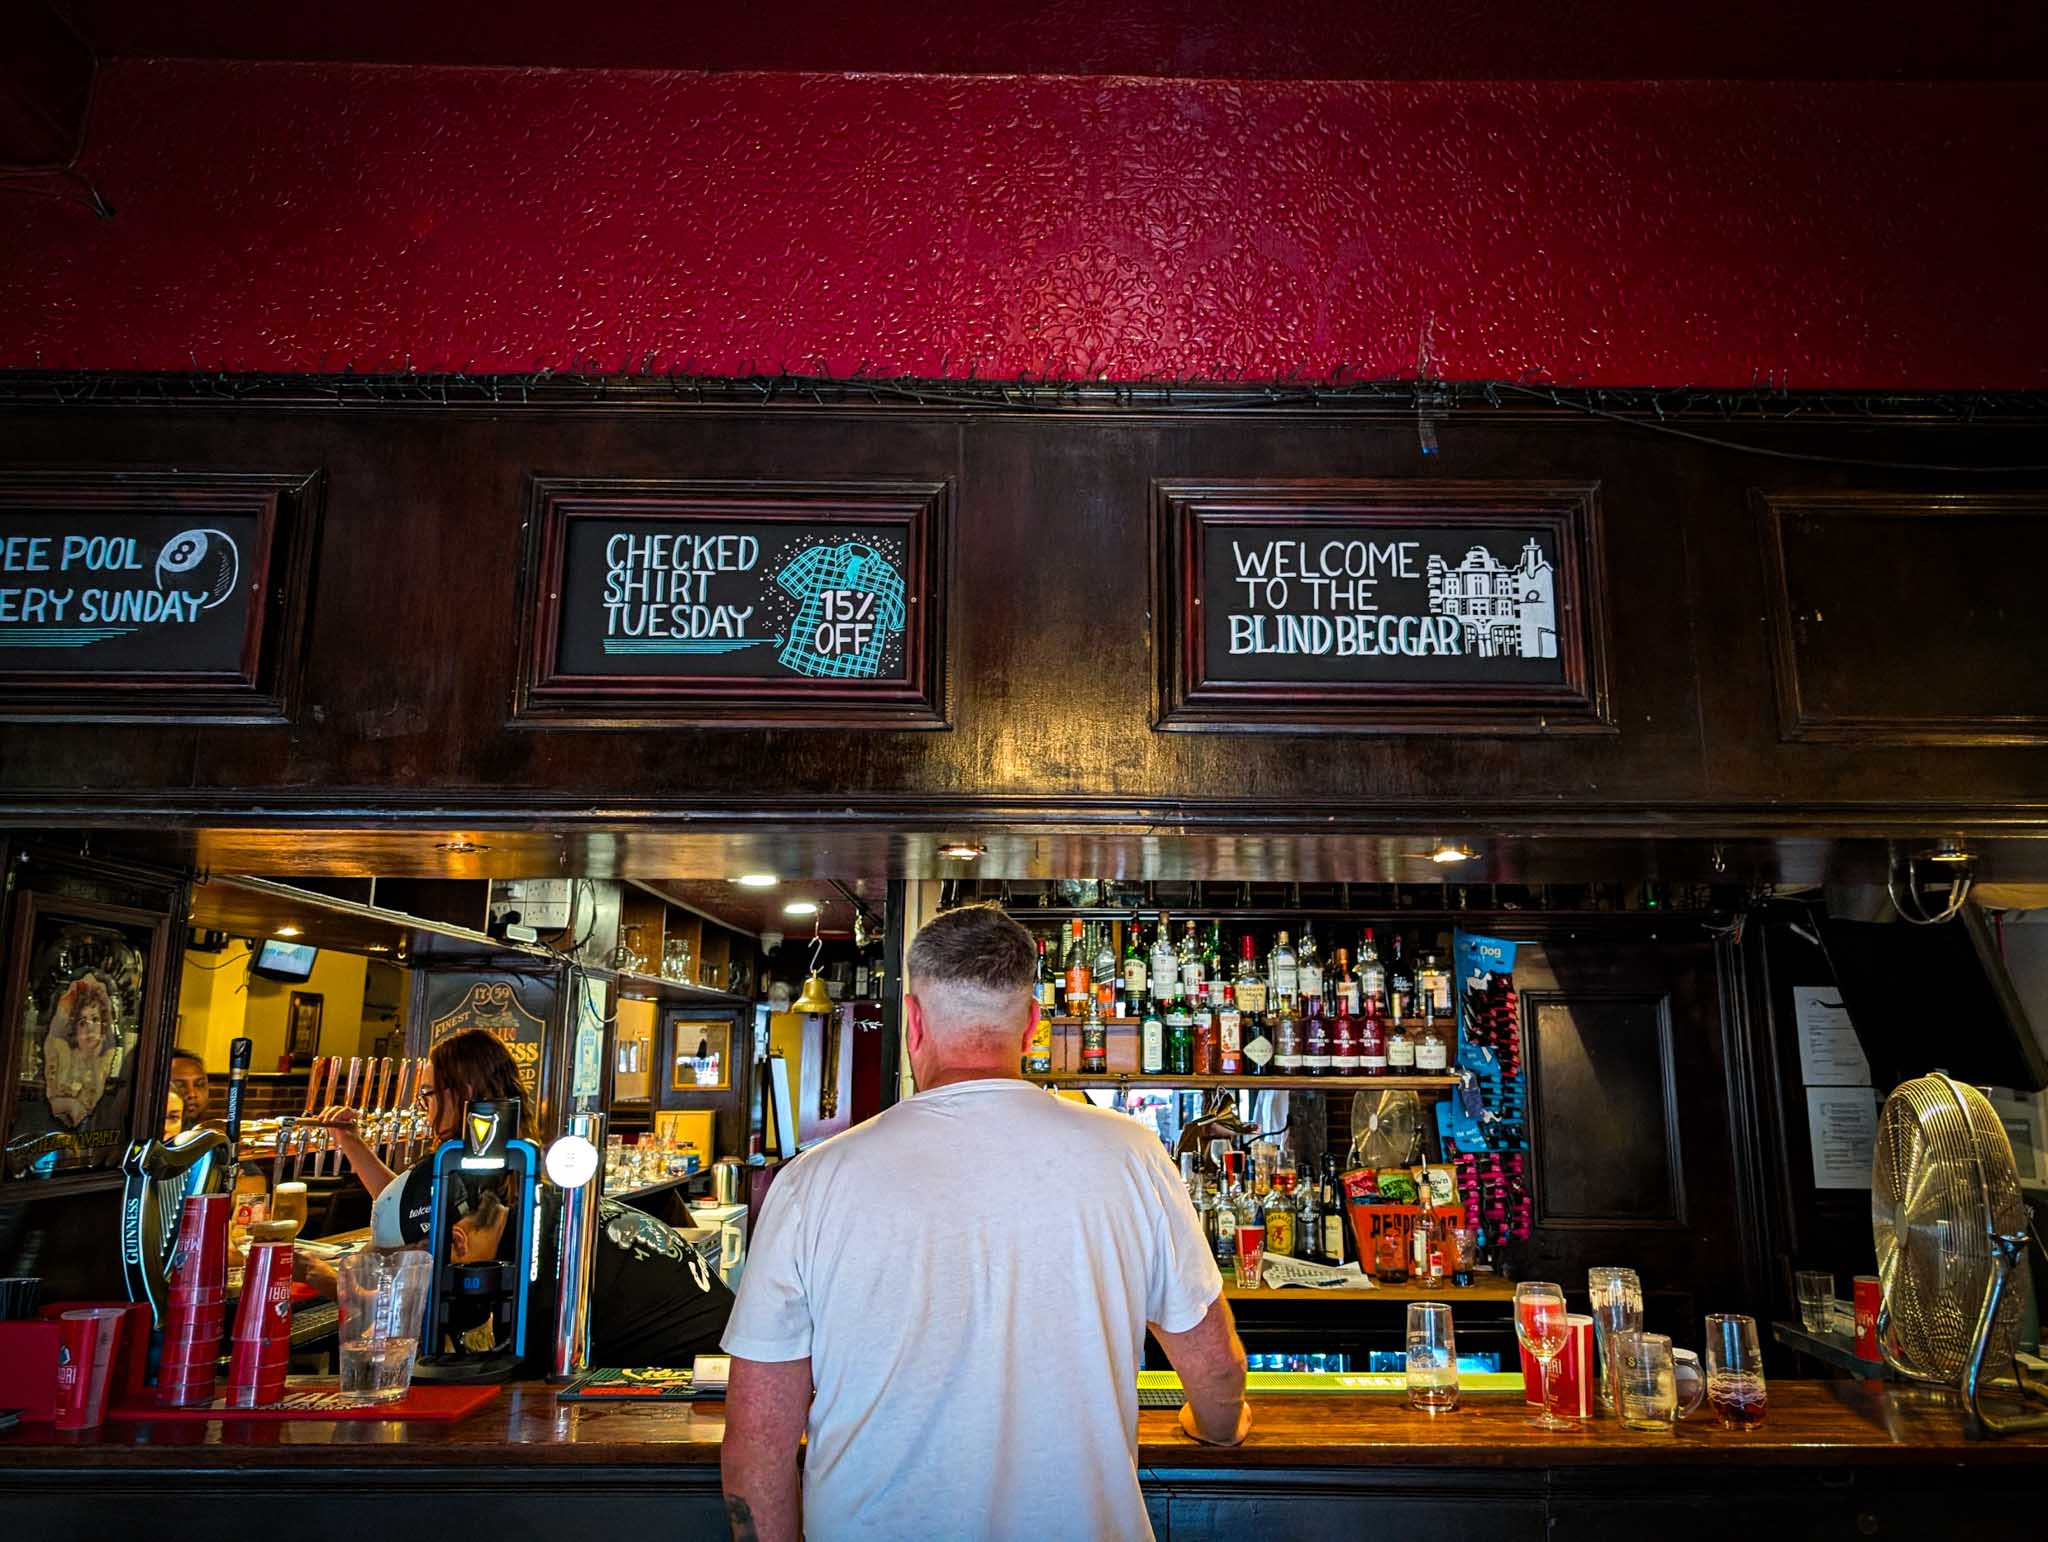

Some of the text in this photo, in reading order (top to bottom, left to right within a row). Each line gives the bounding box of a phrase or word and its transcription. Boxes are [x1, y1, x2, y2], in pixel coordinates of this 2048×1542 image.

[0, 536, 143, 571] EE POOL
[606, 533, 759, 571] CHECKED
[1232, 540, 1420, 579] WELCOME
[603, 570, 716, 603] SHIRT
[1236, 577, 1379, 611] TO THE
[79, 590, 208, 623] SUNDAY
[603, 603, 753, 639] TUESDAY
[820, 590, 876, 622] 15%
[815, 622, 873, 656] OFF
[1228, 614, 1464, 657] BLIND BEGGAR
[1480, 945, 1502, 959] Dog
[434, 1010, 471, 1038] FINEST
[227, 1087, 239, 1122] GUINNESS
[126, 1197, 139, 1265] GUINNESS
[463, 1277, 480, 1289] 0.0
